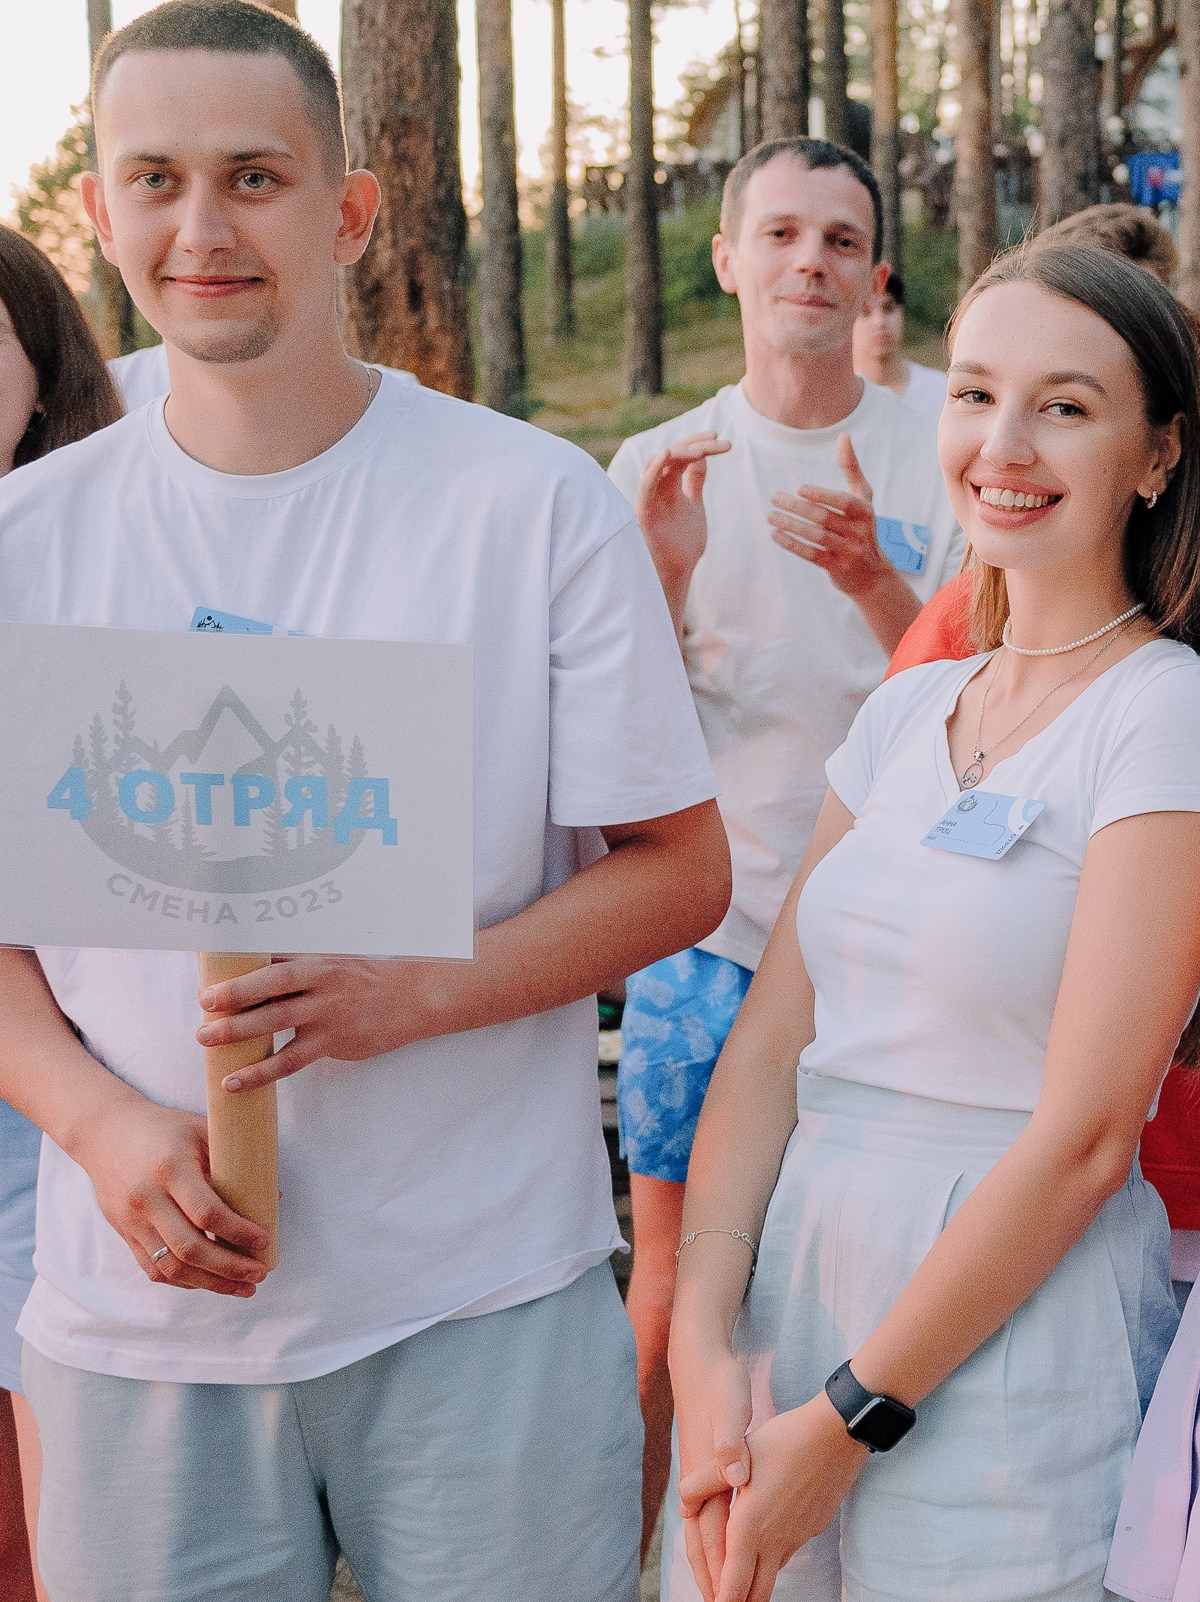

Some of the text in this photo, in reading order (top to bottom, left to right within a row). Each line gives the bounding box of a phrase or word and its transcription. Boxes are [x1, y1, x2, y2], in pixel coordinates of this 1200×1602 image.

[47, 766, 399, 846] 4 ОТРЯД
[106, 872, 343, 925] СМЕНА 2023
